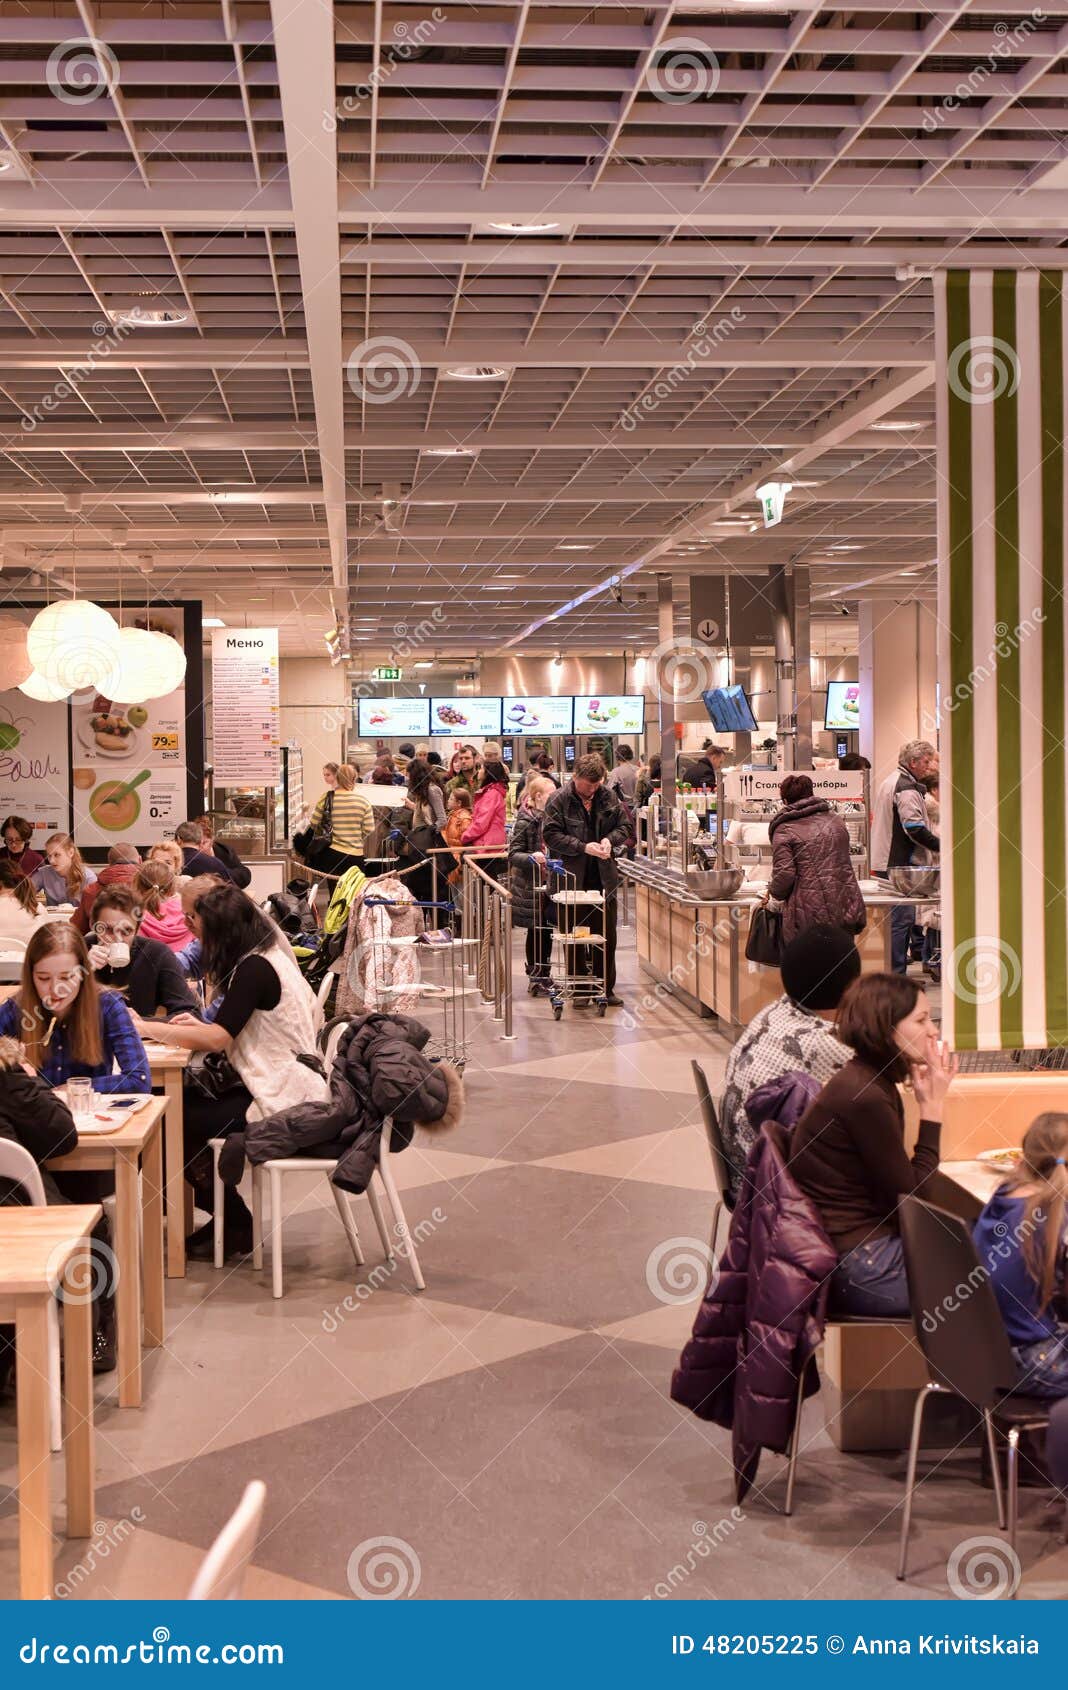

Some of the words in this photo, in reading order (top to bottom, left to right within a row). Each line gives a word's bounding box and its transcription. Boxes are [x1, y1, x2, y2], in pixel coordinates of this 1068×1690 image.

[226, 638, 264, 648] Меню
[153, 736, 176, 747] 79.-
[755, 781, 782, 789] Столо
[811, 780, 848, 789] риборы
